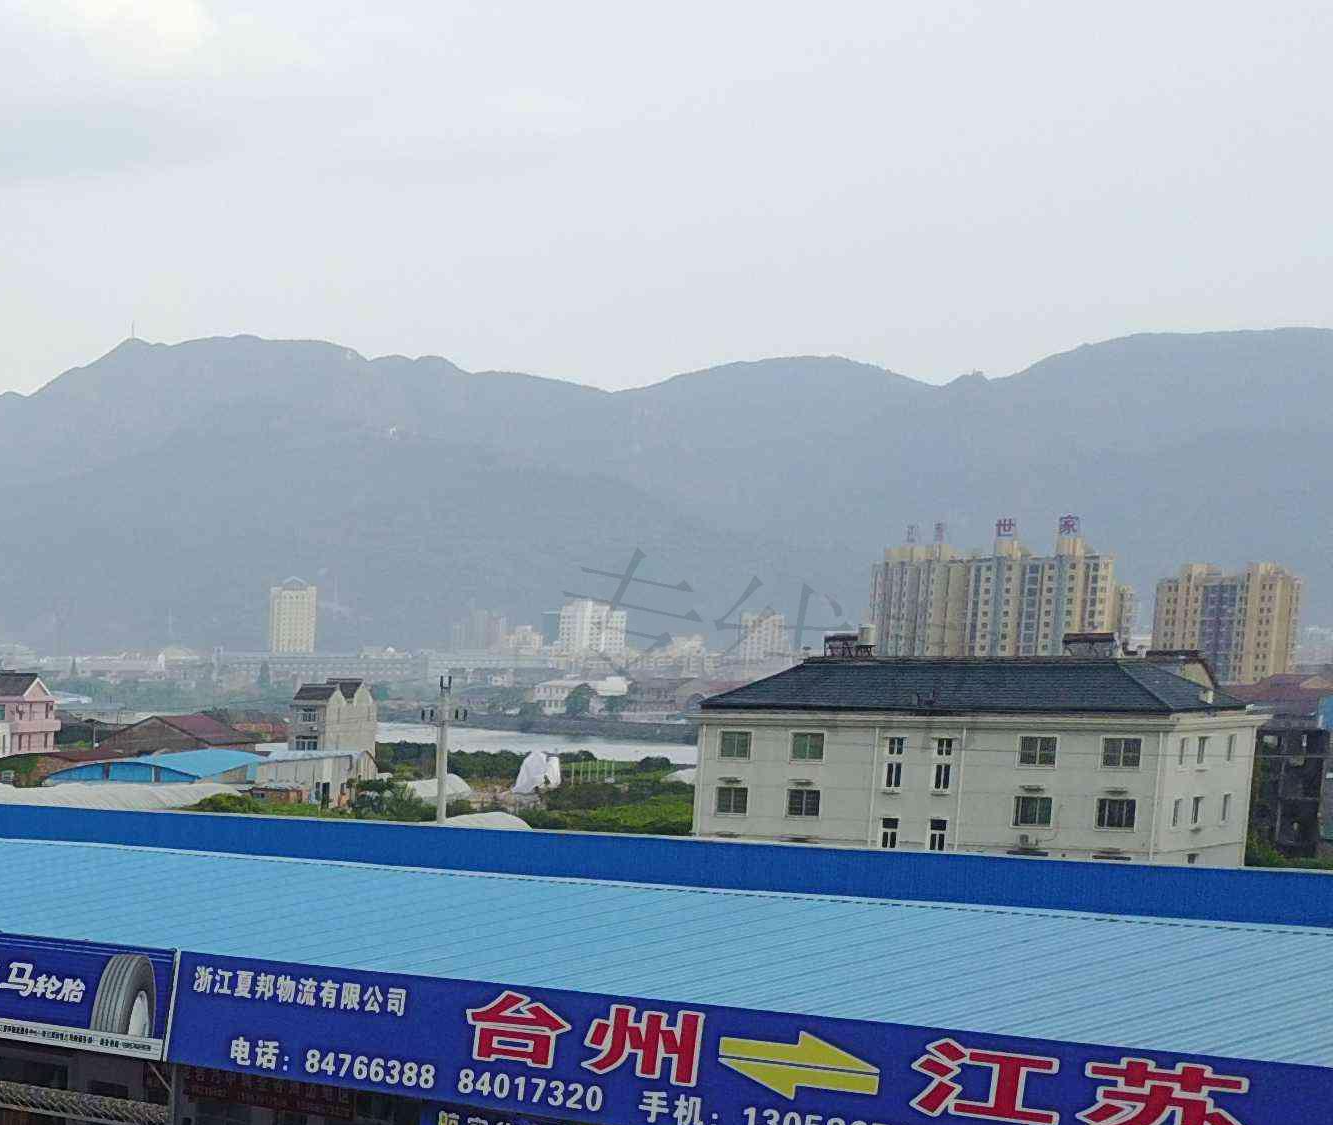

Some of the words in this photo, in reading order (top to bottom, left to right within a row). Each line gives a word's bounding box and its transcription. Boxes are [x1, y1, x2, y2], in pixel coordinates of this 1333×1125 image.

[192, 966, 407, 1016] 浙江夏邦物流有限公司
[466, 990, 706, 1088] 台州
[458, 1069, 603, 1112] 84017320
